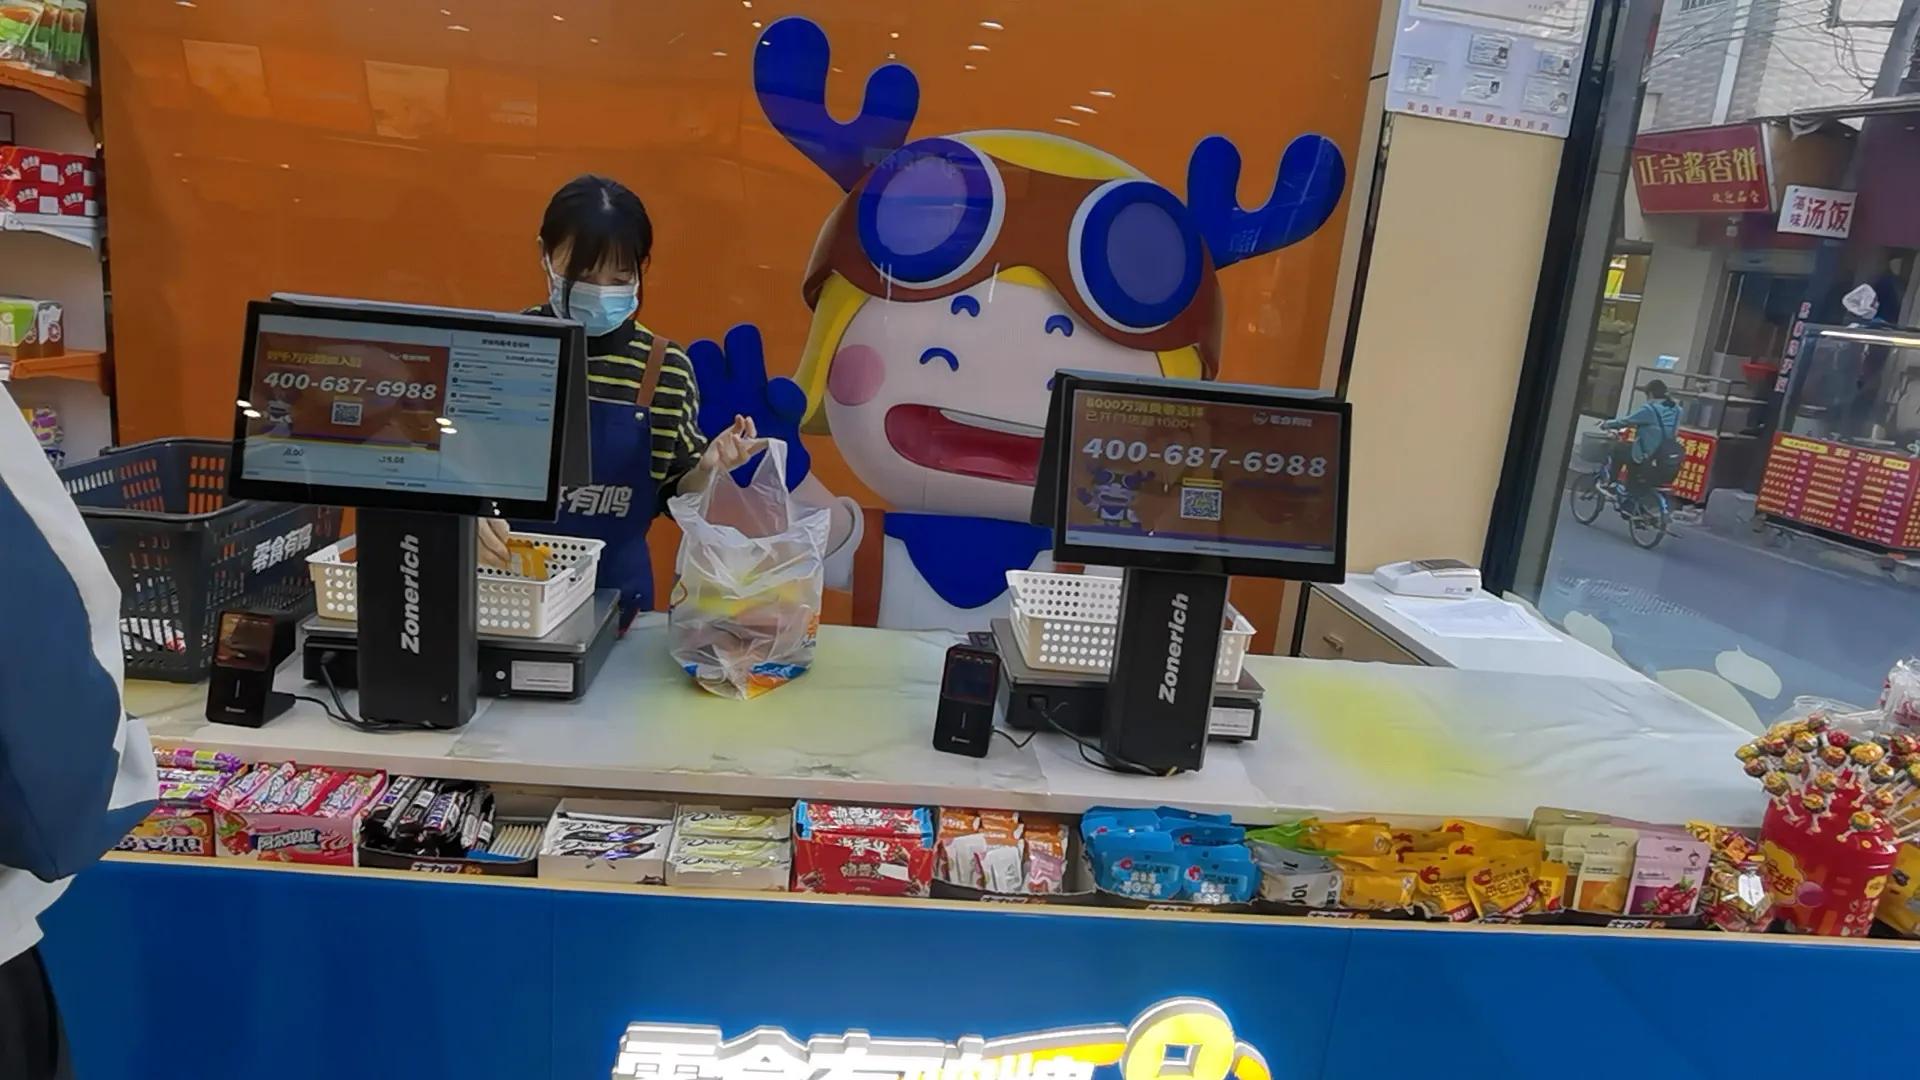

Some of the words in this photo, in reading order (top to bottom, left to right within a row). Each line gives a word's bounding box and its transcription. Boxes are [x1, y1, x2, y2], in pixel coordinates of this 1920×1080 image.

[1636, 147, 1760, 187] 正宗酱香饼
[1801, 198, 1851, 232] 汤饭
[263, 371, 437, 400] 400-687-6988
[1082, 438, 1327, 477] 400-687-6988
[251, 523, 312, 574] 零食有鸣
[400, 534, 420, 655] Zonerich
[1158, 592, 1190, 704] Zonerich
